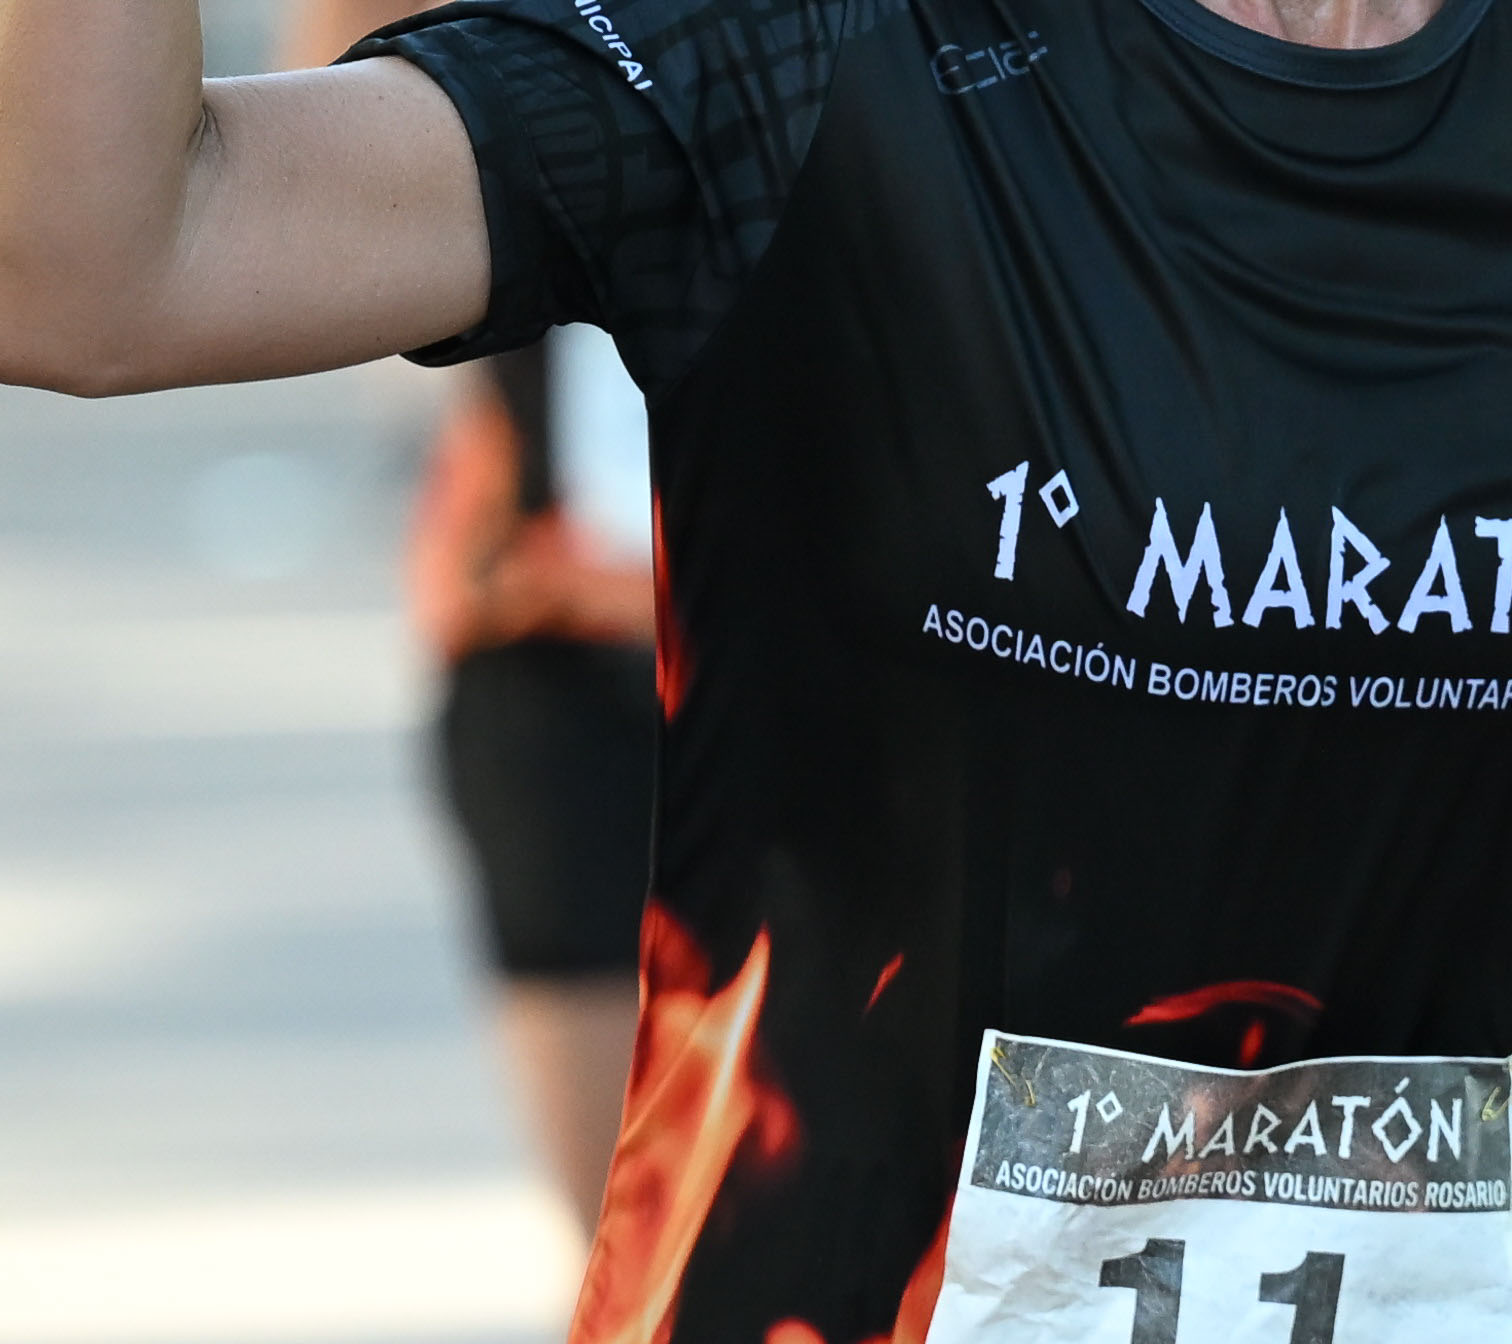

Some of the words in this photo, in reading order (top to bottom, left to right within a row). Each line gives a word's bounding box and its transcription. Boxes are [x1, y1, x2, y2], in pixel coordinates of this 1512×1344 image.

[921, 602, 1137, 690] ASOCIACIÓN
[1146, 661, 1338, 707] BOMBEROS
[1140, 1077, 1464, 1165] MARATÓN
[994, 1159, 1134, 1202] ASOCIACIÓN
[1137, 1169, 1257, 1201] BOMBEROS
[1263, 1171, 1420, 1208] VOLUNTARIOS
[1422, 1178, 1508, 1208] ROSARIO
